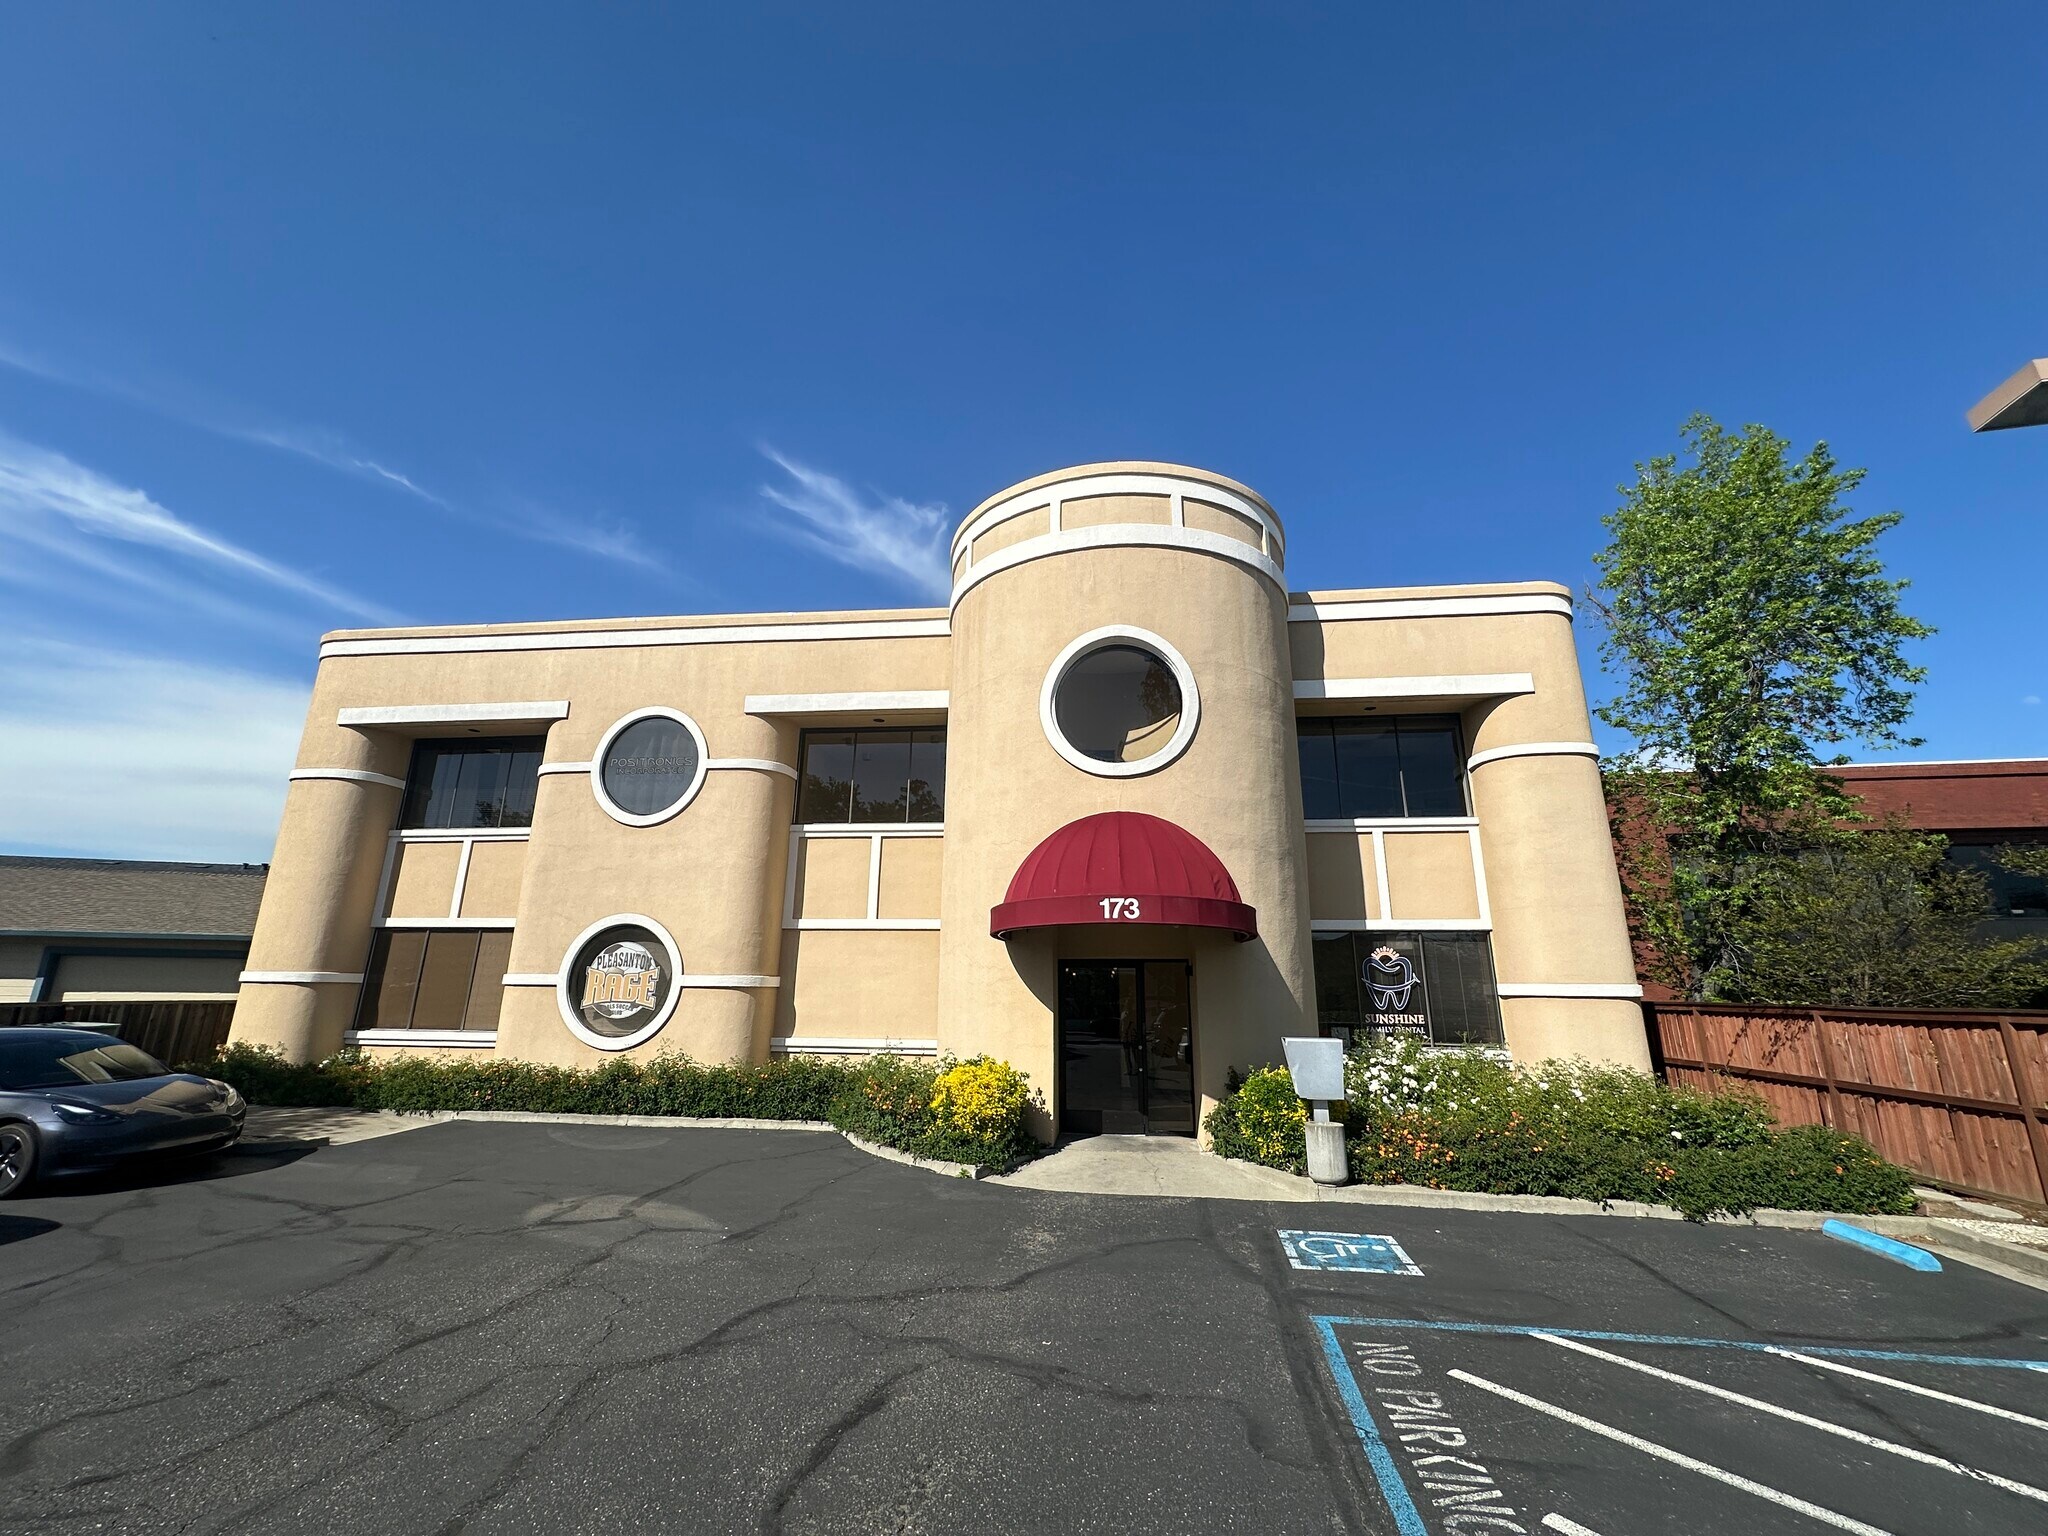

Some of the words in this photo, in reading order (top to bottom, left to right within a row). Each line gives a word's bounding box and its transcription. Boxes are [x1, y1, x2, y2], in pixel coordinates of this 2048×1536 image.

[610, 757, 693, 767] POSITRONICS
[1099, 897, 1140, 919] 173
[596, 952, 652, 970] PLEASANTON
[580, 966, 660, 1010] RAGE
[1365, 1013, 1425, 1024] SUNSHINE
[1352, 1342, 1424, 1376] NO
